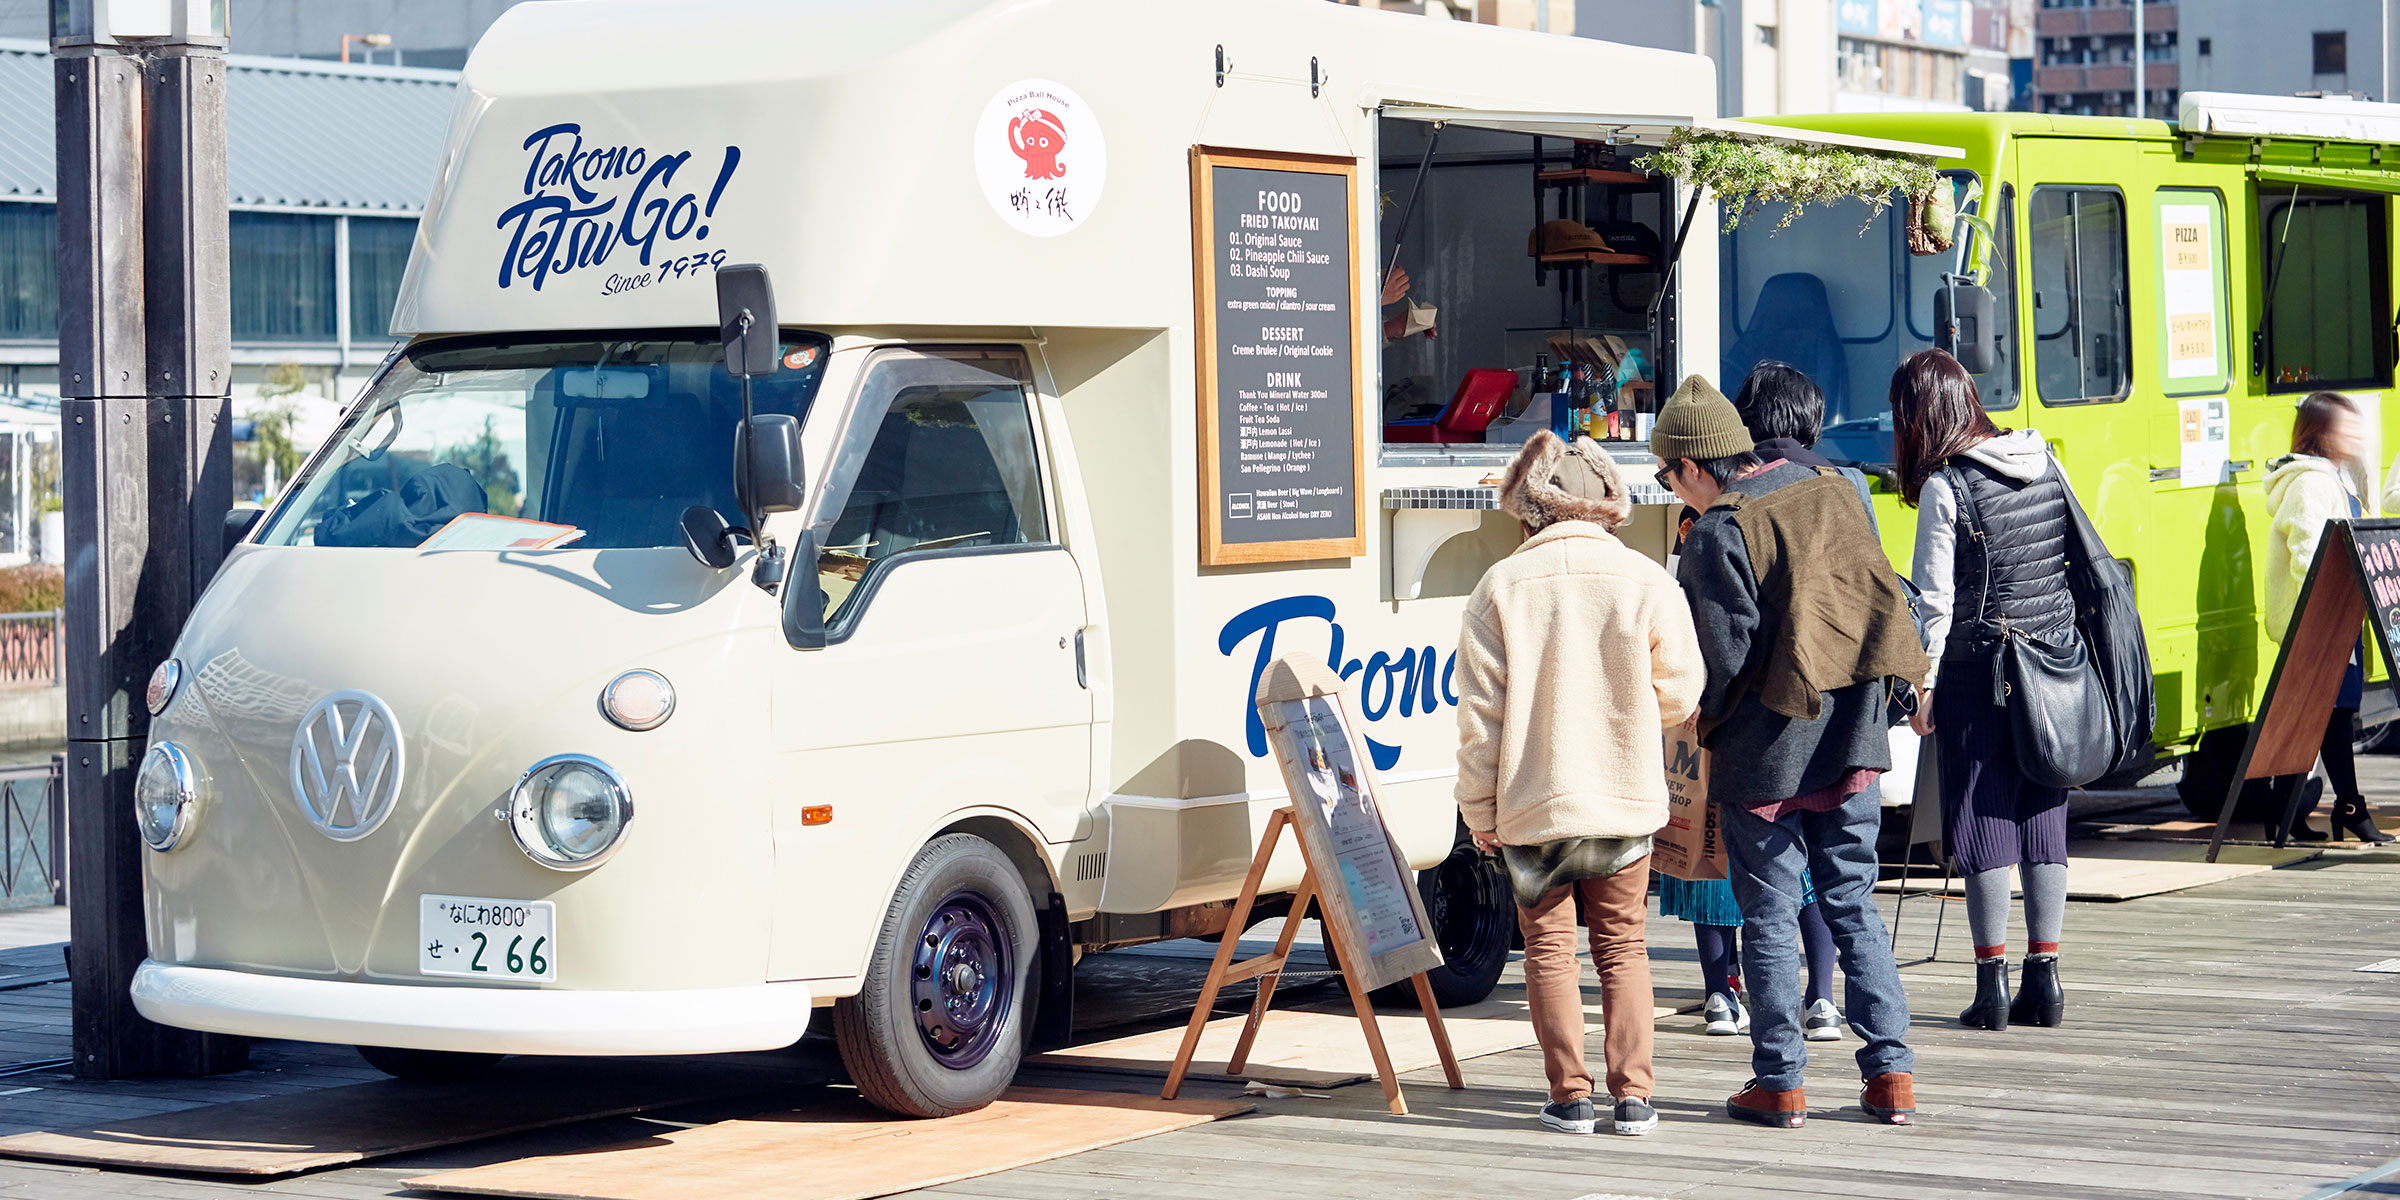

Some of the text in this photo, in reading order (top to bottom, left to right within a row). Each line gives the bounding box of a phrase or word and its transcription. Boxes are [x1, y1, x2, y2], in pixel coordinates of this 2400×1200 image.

[1007, 91, 1070, 109] Pizza Ball House
[523, 123, 646, 204] Takono
[1259, 191, 1301, 213] FOOD
[1241, 214, 1319, 230] FRIED TAKOYAKI
[1230, 232, 1302, 248] 01. Original Sauce
[2175, 228, 2198, 243] PIZZA
[1230, 248, 1329, 264] 02. Pineapple Chili Sauce
[601, 249, 727, 296] Since 1979
[1231, 264, 1290, 281] 03. Dashi Soup
[1266, 287, 1297, 298] TOPPING
[1227, 300, 1242, 309] extra
[1243, 302, 1259, 311] green
[1260, 301, 1275, 310] onion
[1280, 301, 1301, 311] cilantro
[1306, 303, 1318, 311] sour
[1319, 303, 1335, 311] cream
[1262, 327, 1303, 341] DESSERT
[1232, 344, 1254, 355] Creme
[1256, 345, 1277, 356] Brulee
[1284, 345, 1309, 357] Original
[1311, 346, 1333, 356] Cookie
[1267, 372, 1301, 388] DRINK
[1239, 390, 1327, 399] Thank You Mineral Water 300ml
[1239, 403, 1258, 412] Coffee
[1264, 403, 1274, 412] Tea
[1240, 415, 1280, 424] Fruit Tea Soda
[1259, 427, 1277, 436] Lemon
[1279, 427, 1292, 435] Lassi
[1259, 439, 1287, 448] Lemonade
[1241, 452, 1263, 461] Ramune
[1241, 464, 1251, 473] San
[1253, 464, 1280, 474] Pellegrino
[1278, 488, 1288, 496] Beer
[1300, 488, 1313, 496] Wave
[1267, 500, 1278, 509] Beer
[1282, 511, 1298, 520] Alcohol
[1300, 511, 1309, 519] Beer
[1669, 792, 1692, 807] HOP
